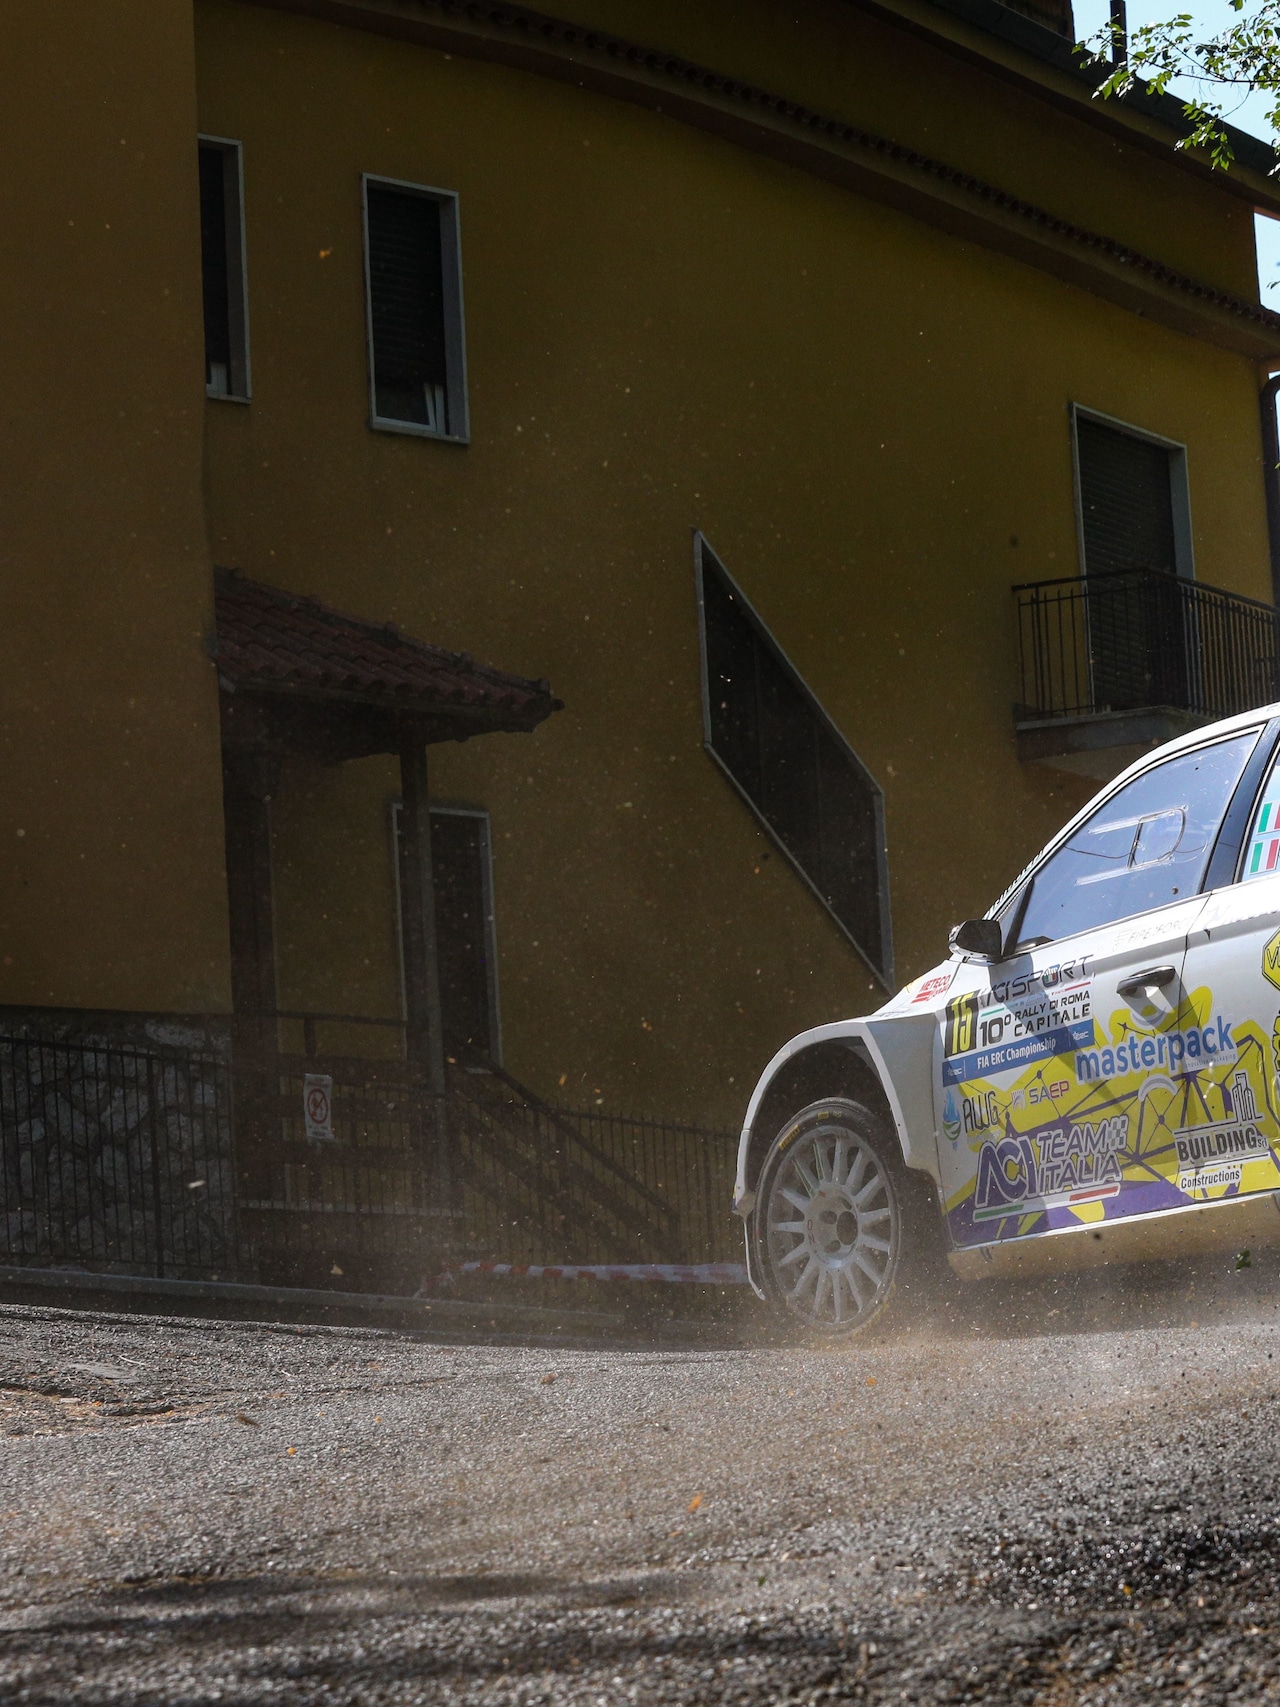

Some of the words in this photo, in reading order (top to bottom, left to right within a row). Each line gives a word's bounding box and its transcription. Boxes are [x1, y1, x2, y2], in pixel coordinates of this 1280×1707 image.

[951, 991, 975, 1055] 15
[1014, 1002, 1047, 1022] RALLY
[1049, 1000, 1059, 1010] DI
[1060, 990, 1091, 1007] ROMA
[1014, 1002, 1091, 1038] CAPITALE
[977, 1055, 990, 1070] FIA
[991, 1052, 1005, 1066] ERC
[1006, 1037, 1057, 1060] Championship
[1076, 1015, 1235, 1082] masterpack
[1029, 1080, 1070, 1105] SAEP
[1176, 1127, 1257, 1162] BUILDING
[976, 1137, 1037, 1207] ACI
[1038, 1120, 1108, 1162] TEAM
[1039, 1151, 1122, 1194] ITALIA
[1181, 1169, 1240, 1189] Constructions
